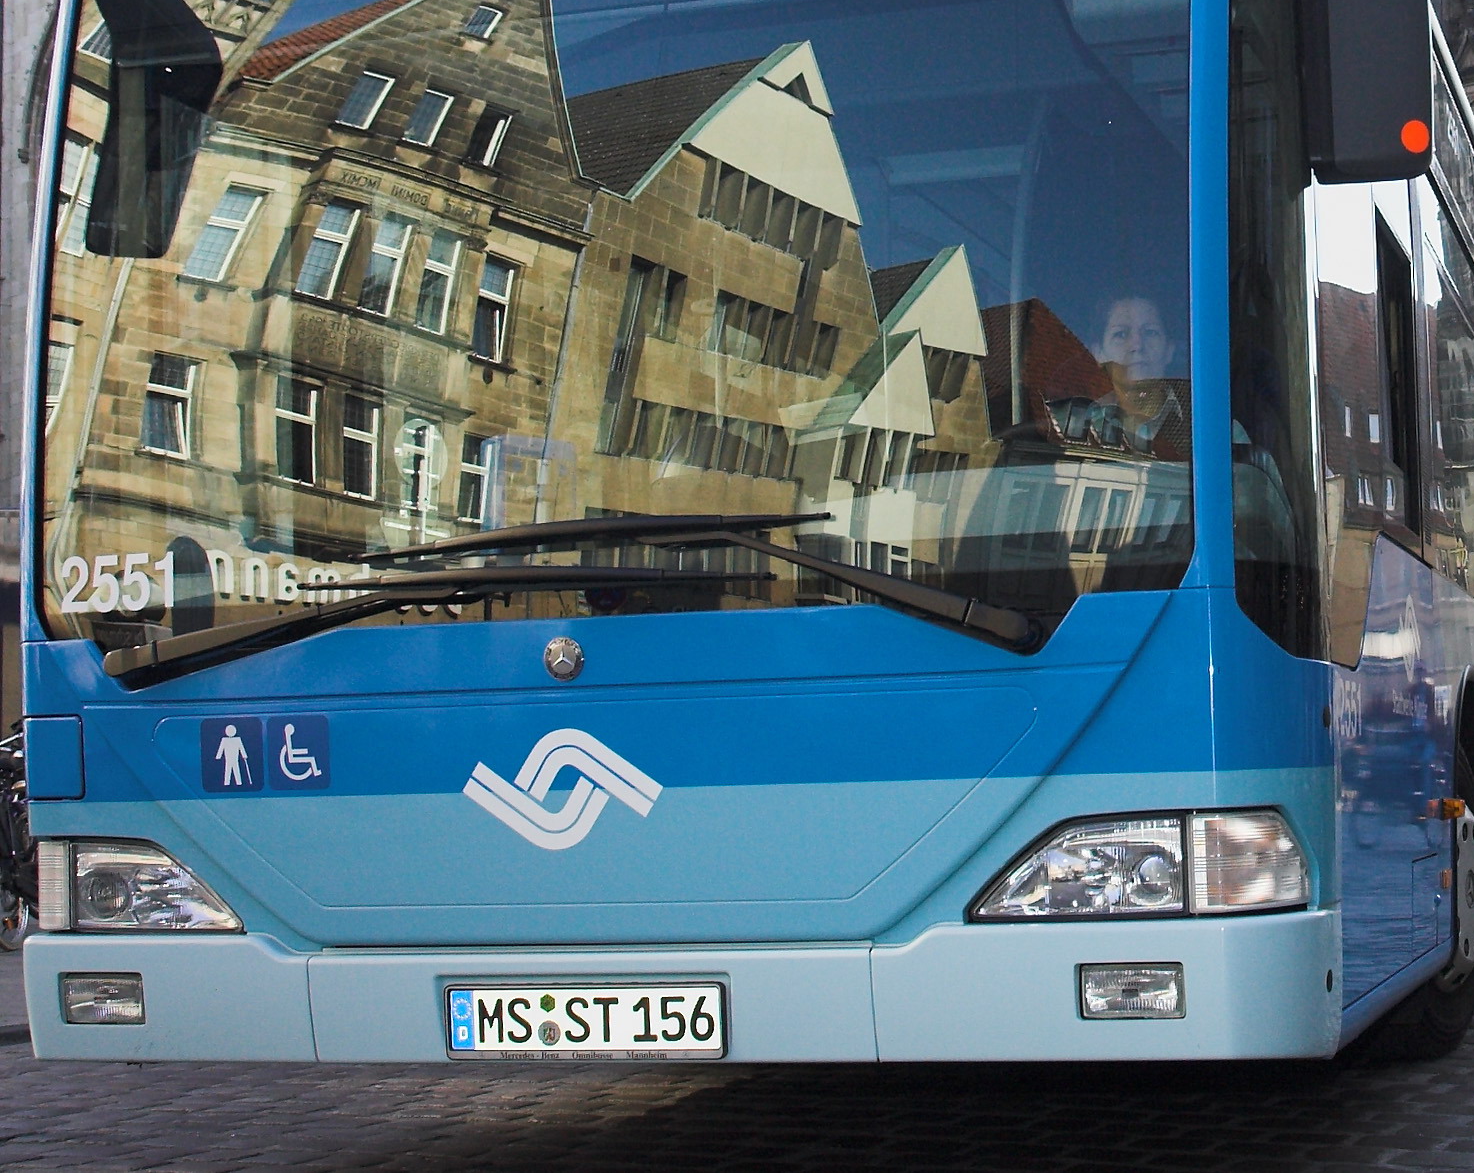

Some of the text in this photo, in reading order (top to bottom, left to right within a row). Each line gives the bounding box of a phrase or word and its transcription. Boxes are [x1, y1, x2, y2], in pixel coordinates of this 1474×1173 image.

[61, 551, 175, 613] 2551
[458, 1026, 469, 1042] D
[478, 996, 715, 1044] MS ST 156
